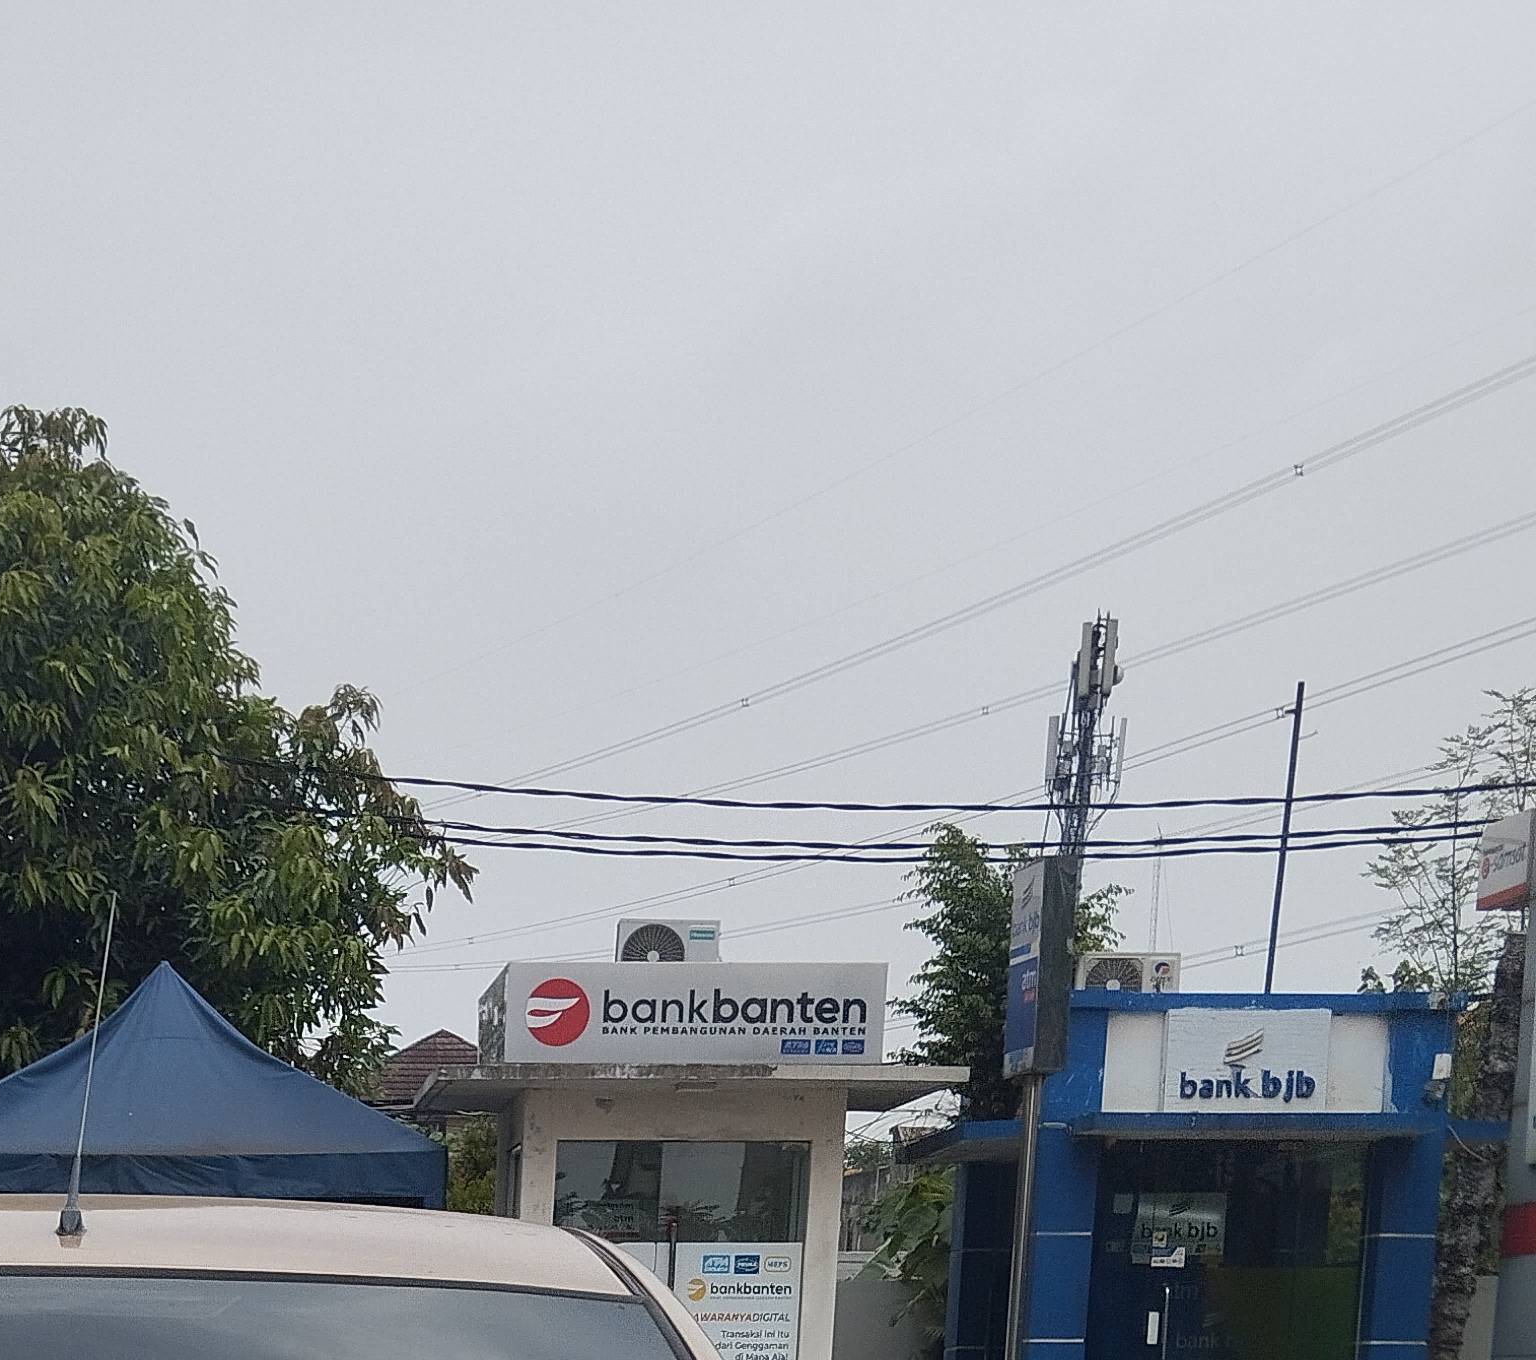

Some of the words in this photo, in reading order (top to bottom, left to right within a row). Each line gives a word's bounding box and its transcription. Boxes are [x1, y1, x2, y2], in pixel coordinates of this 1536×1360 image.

[602, 988, 867, 1024] bankbanten
[602, 1026, 637, 1036] BANK
[643, 1026, 747, 1036] PEMBANGUNAN
[752, 1026, 807, 1036] DAERAH
[813, 1026, 867, 1036] BANTEN
[1179, 1070, 1251, 1099] bank
[1261, 1069, 1316, 1103] bjb
[1187, 1221, 1218, 1241] bjb
[710, 1282, 792, 1295] bankbanten
[720, 1330, 762, 1339] Transaksi
[777, 1330, 790, 1339] Itu
[734, 1352, 743, 1360] di
[746, 1353, 769, 1360] Mana
